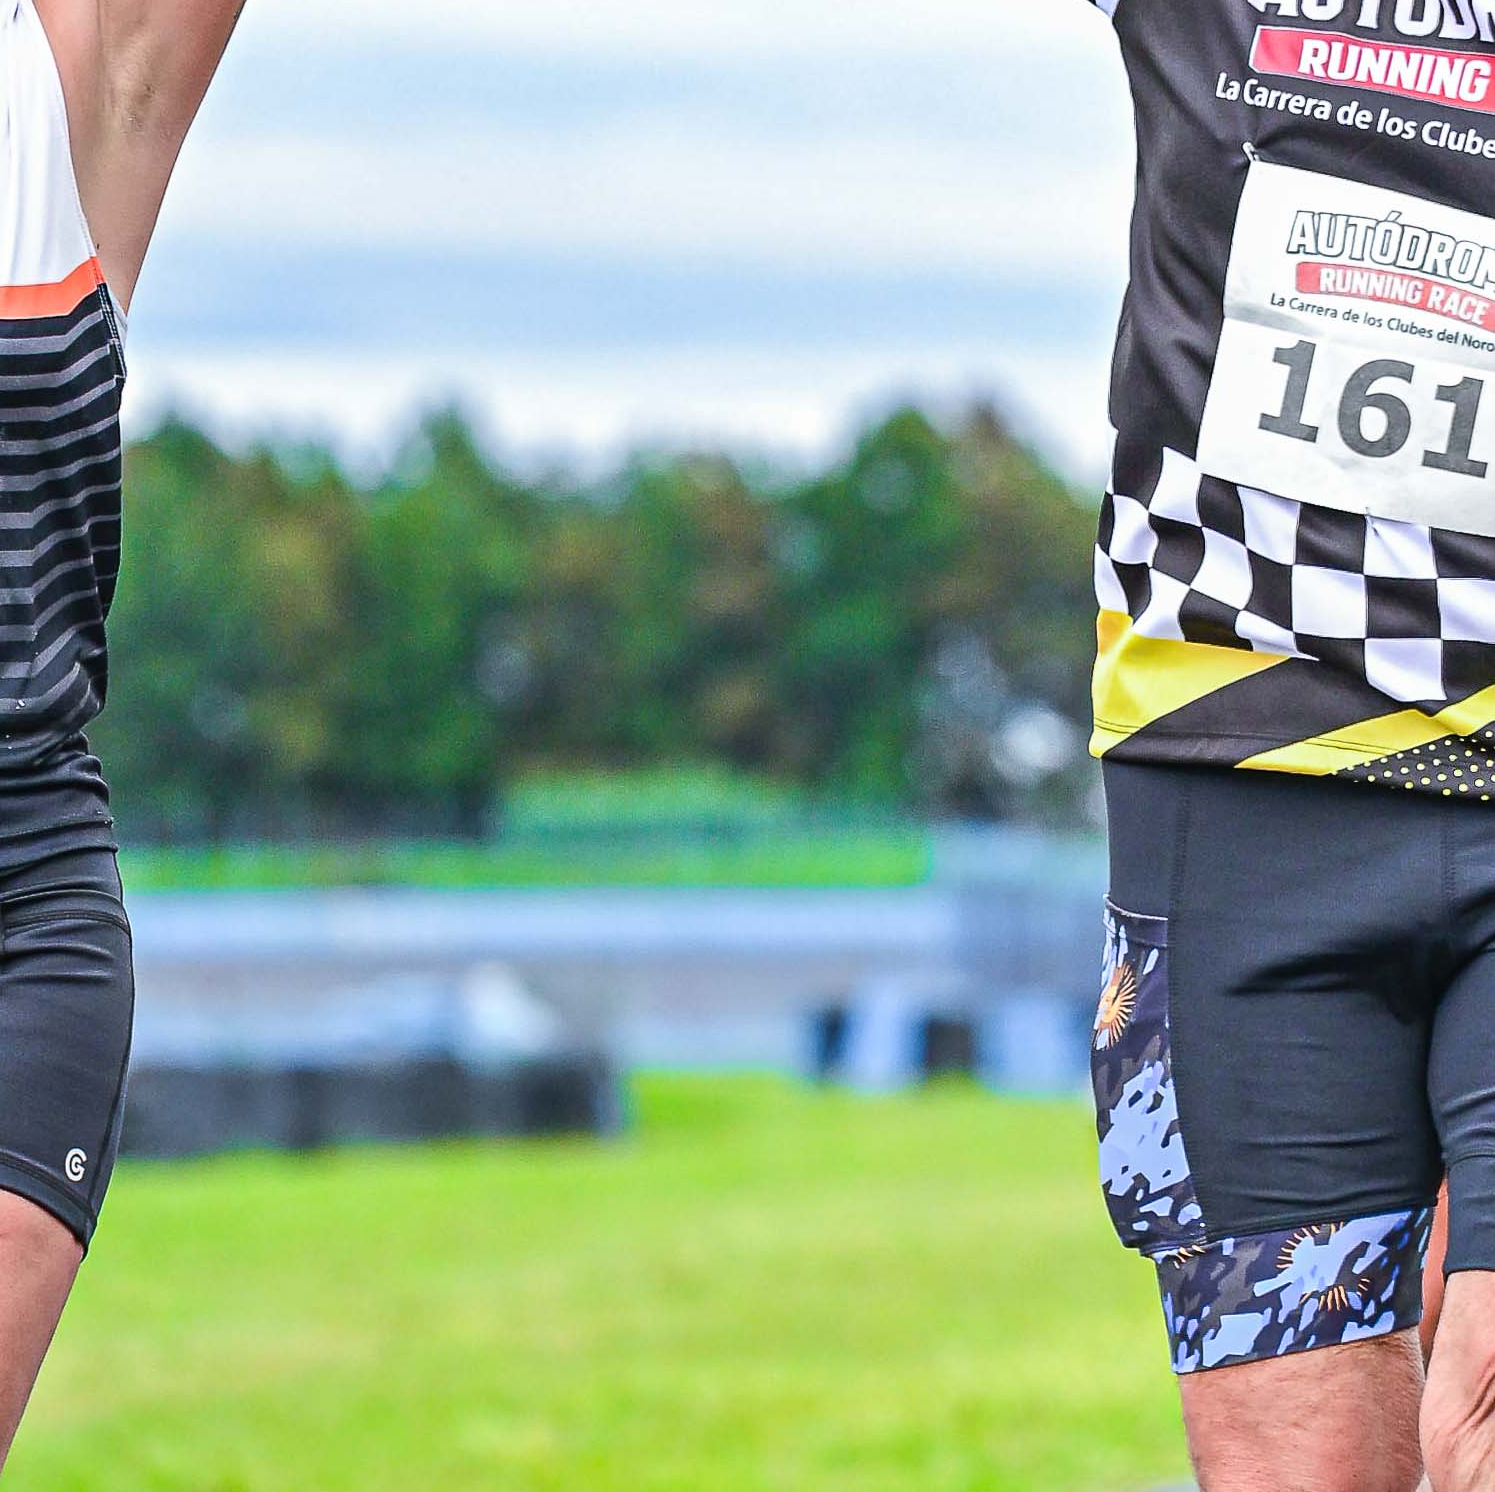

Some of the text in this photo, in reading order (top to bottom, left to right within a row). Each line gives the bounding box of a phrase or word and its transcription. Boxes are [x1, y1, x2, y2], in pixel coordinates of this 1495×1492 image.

[1298, 39, 1491, 102] RUNNING
[1216, 72, 1495, 159] La Carrera de los Clube
[1270, 292, 1286, 307] La
[1289, 297, 1338, 319] Carrera
[1342, 307, 1360, 324] de
[1363, 312, 1382, 328] los
[1387, 317, 1433, 339] Clubes
[1436, 328, 1459, 344] del
[1320, 267, 1491, 325] RUNNING RACE
[1258, 339, 1489, 479] 161
